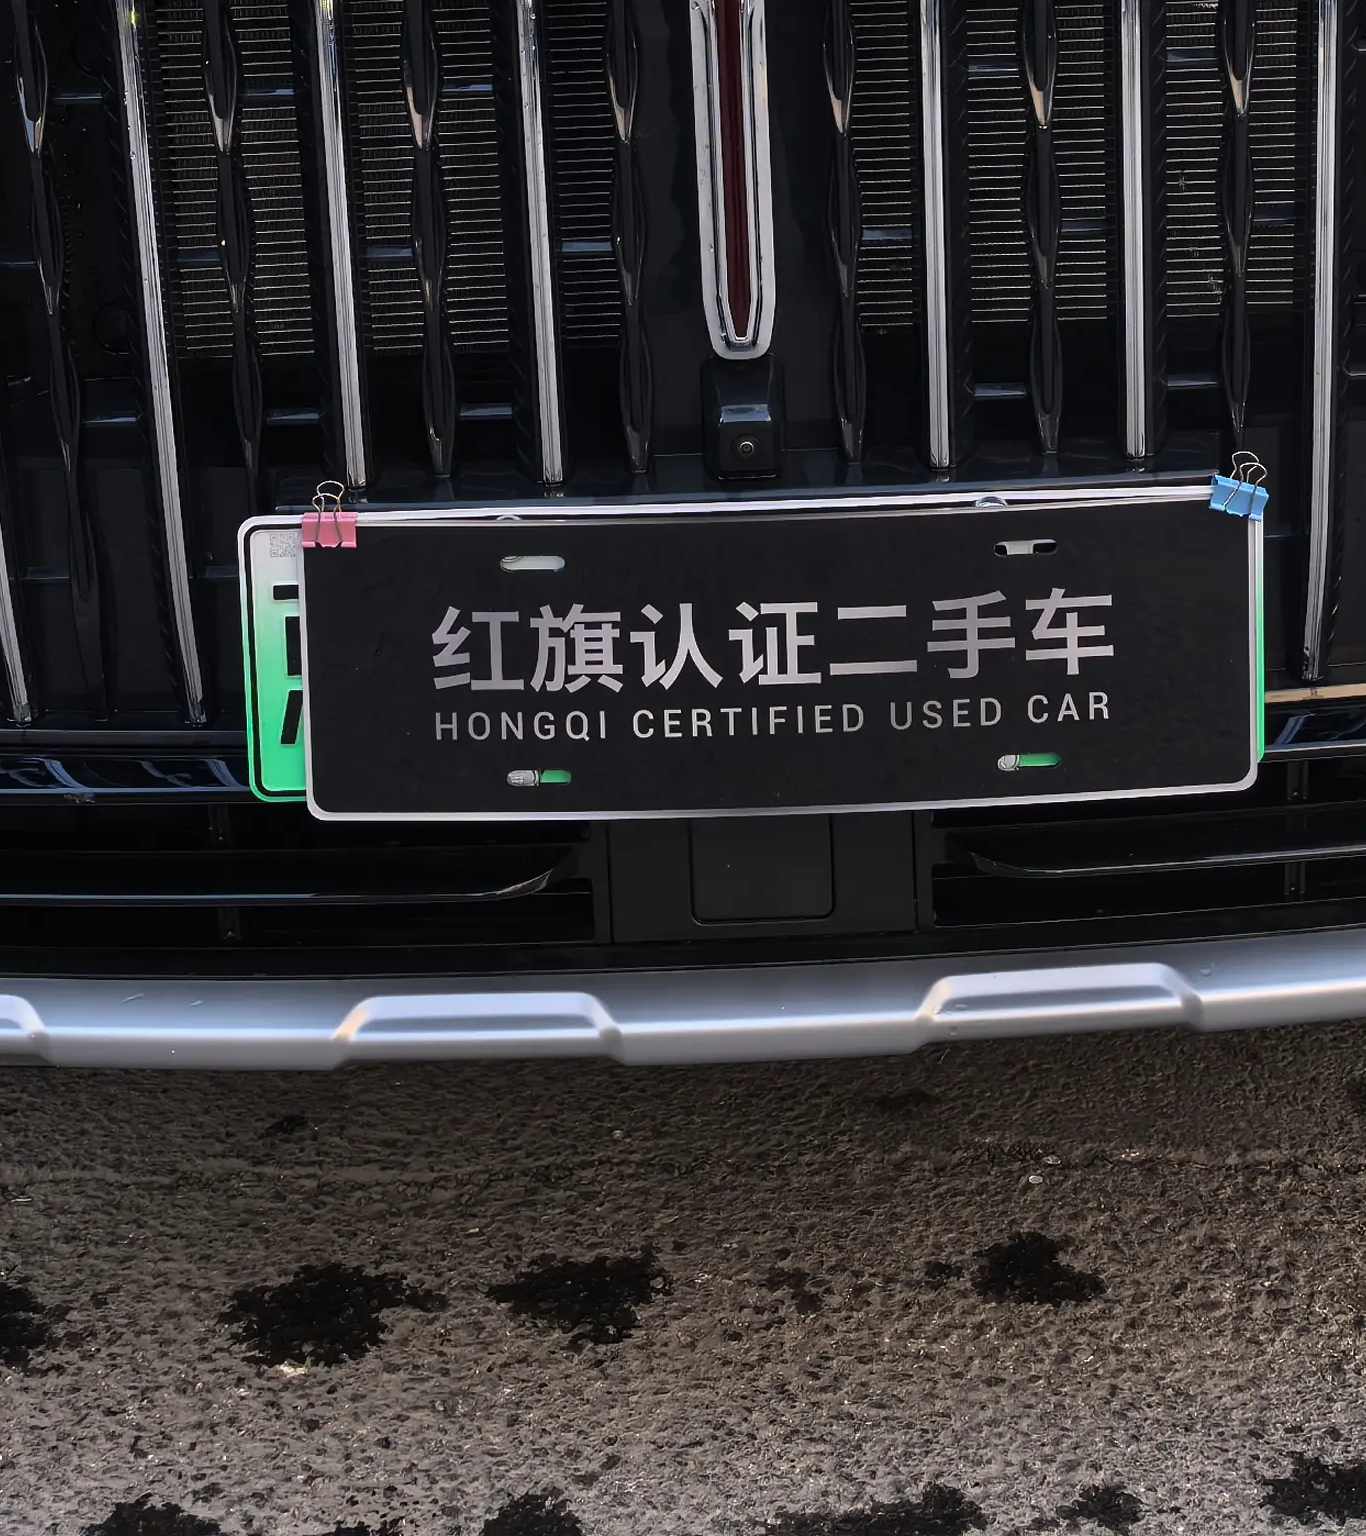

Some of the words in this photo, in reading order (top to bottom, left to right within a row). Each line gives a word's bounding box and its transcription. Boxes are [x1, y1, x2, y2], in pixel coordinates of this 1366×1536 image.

[432, 587, 1114, 693] 红旗认证二手车
[435, 710, 606, 741] HONGQI
[633, 704, 864, 738] CERTIFIED
[890, 698, 1002, 730] USED
[1027, 692, 1109, 723] CAR
